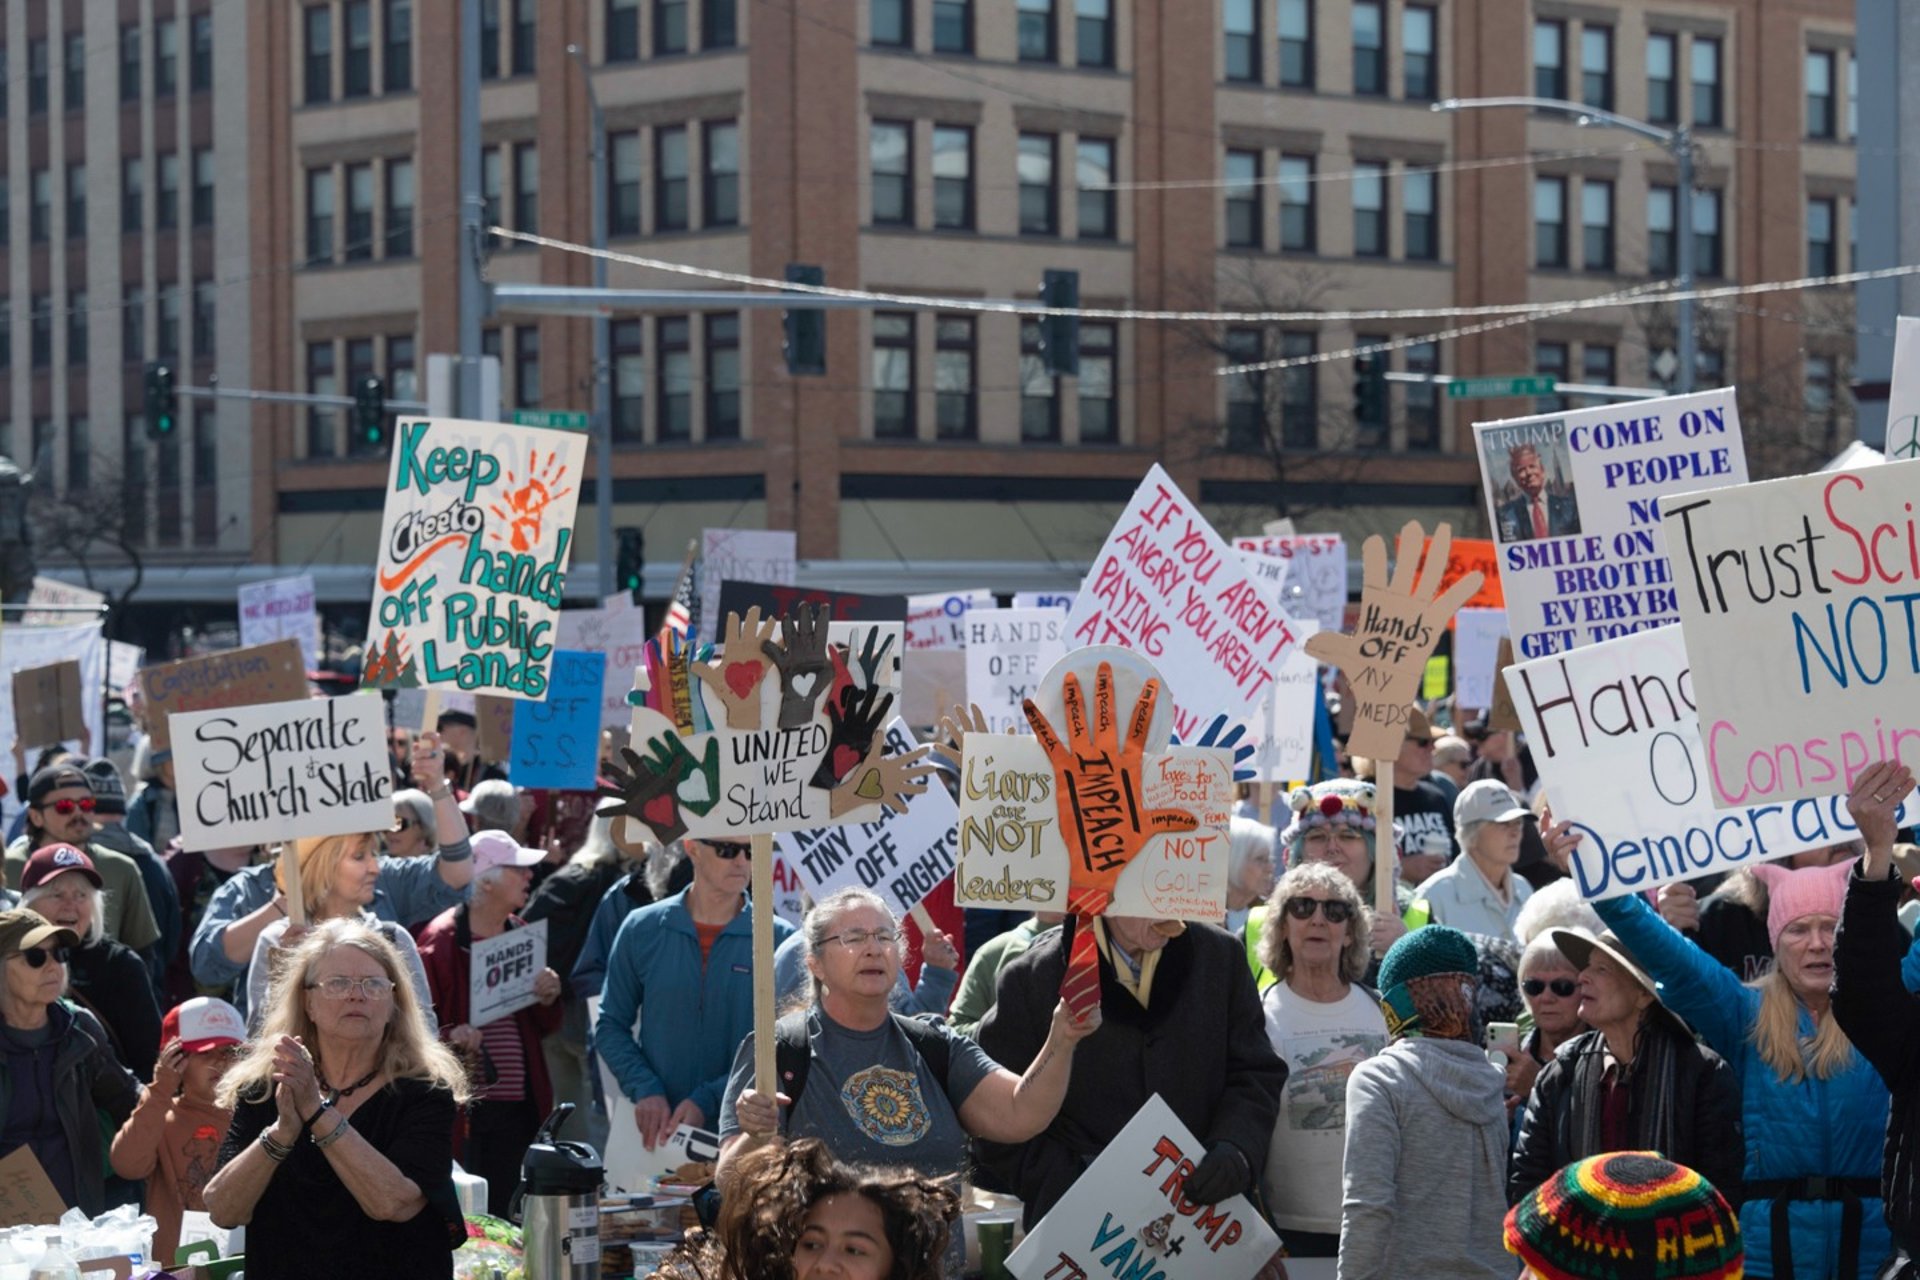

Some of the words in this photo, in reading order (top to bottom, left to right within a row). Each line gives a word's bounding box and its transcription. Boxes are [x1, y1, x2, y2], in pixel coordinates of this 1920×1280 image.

[1484, 423, 1563, 450] TRUMP
[1569, 415, 1663, 453] COME
[1679, 407, 1726, 438] ON
[396, 422, 500, 502] Keep
[1603, 448, 1732, 489] PEOPLE
[390, 497, 484, 563] Cheeto
[1507, 536, 1605, 572] SMILE
[1613, 529, 1655, 559] ON
[460, 528, 571, 610] hands
[1139, 483, 1183, 533] IF
[1173, 519, 1222, 586] YOU
[1217, 578, 1295, 663] AREN'T
[1554, 557, 1673, 595] BROTH
[1664, 499, 1832, 614] Trust
[379, 574, 437, 628] OFF
[443, 592, 552, 661] Public
[1092, 555, 1171, 658] PAYING
[1176, 585, 1218, 643] YOU
[1363, 603, 1432, 648] Hands
[971, 621, 1058, 644] HANDS
[1359, 635, 1410, 664] OFF
[1521, 628, 1577, 659] GET
[1792, 592, 1920, 695] NOT
[423, 638, 547, 697] Lands
[989, 655, 1038, 676] OFF
[1064, 682, 1082, 738] impeach
[1097, 673, 1111, 734] impeach
[1131, 683, 1155, 739] impeach
[1357, 702, 1410, 728] MEDS
[195, 699, 366, 791] Separate
[732, 724, 828, 765] UNITED
[196, 766, 311, 826] Church
[318, 761, 390, 807] State
[764, 760, 799, 786] WE
[964, 755, 1053, 804] Liars
[1173, 783, 1207, 802] Food
[726, 779, 811, 827] Stand
[992, 803, 1027, 821] are
[1076, 751, 1127, 873] IMPEACH
[1151, 813, 1198, 828] impeach
[801, 824, 853, 886] TINY
[962, 815, 1054, 858] NOT
[1164, 836, 1217, 862] NOT
[1563, 786, 1920, 898] Democrac
[854, 832, 899, 889] OFF
[957, 861, 1056, 903] leaders
[1154, 869, 1211, 894] GOLF
[485, 939, 534, 967] HANDS
[486, 953, 534, 989] OFF!
